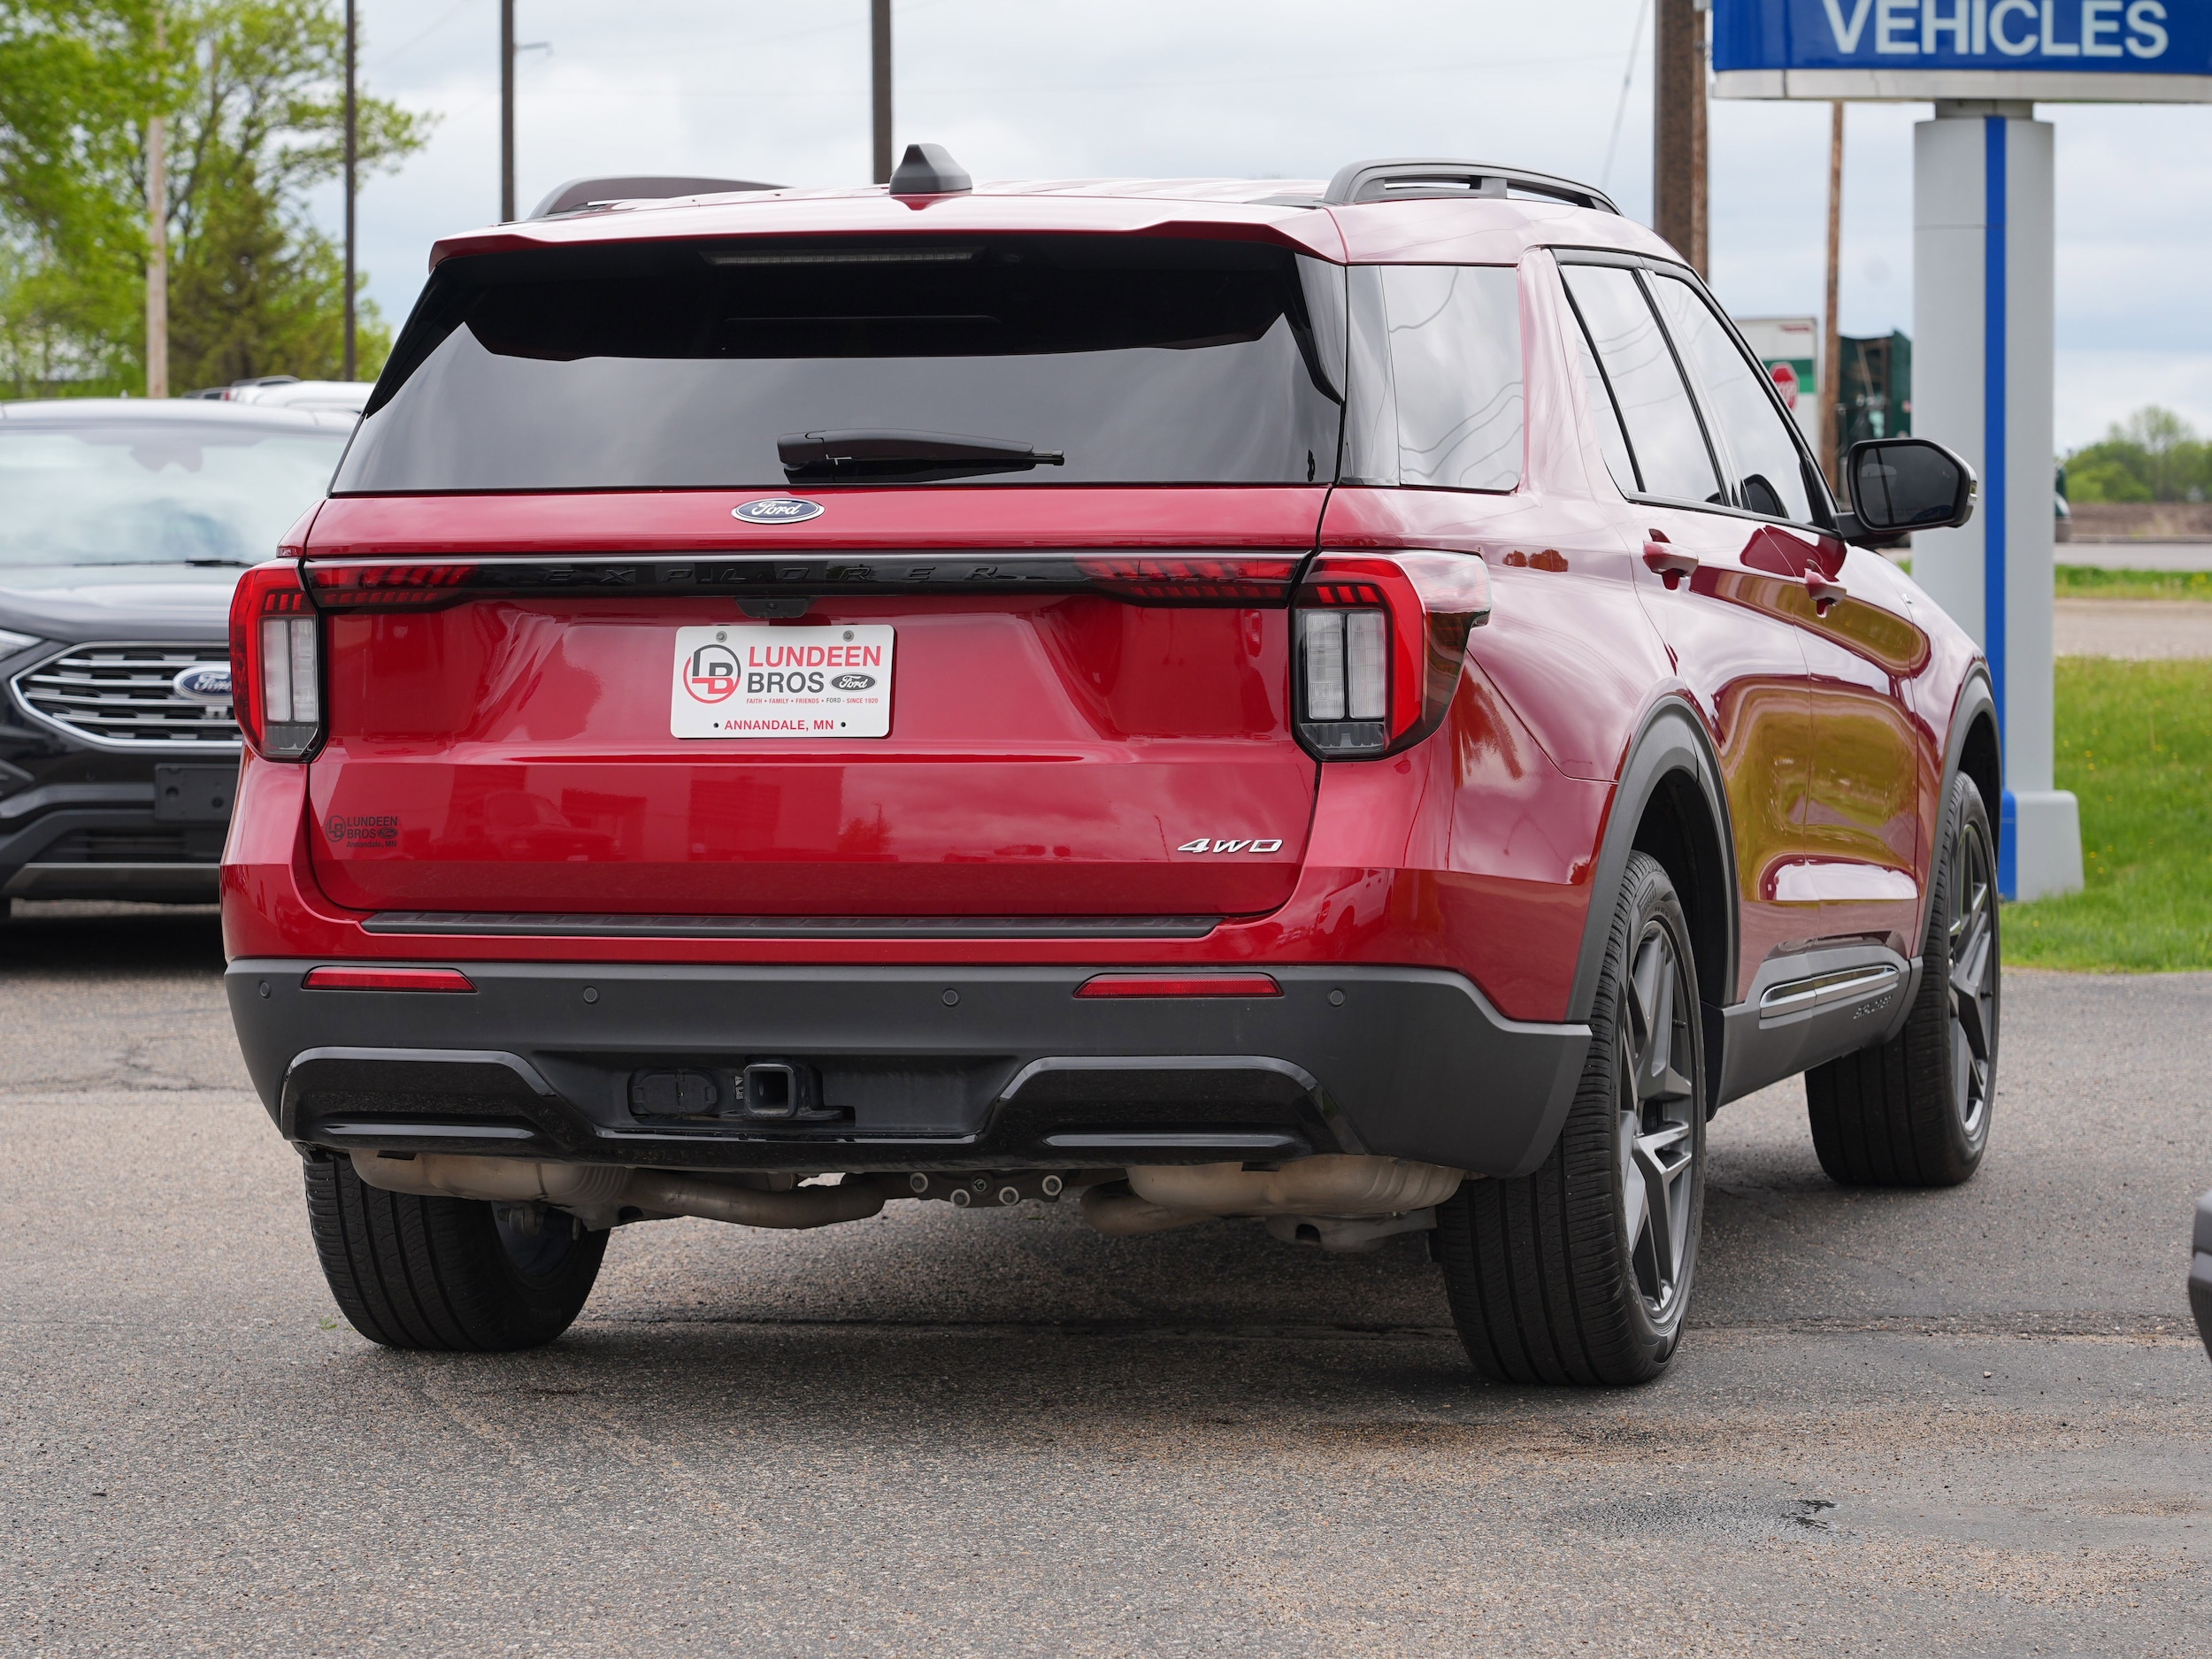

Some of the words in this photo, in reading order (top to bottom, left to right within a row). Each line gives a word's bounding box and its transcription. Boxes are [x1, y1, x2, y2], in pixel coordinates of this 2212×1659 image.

[1821, 0, 2170, 58] VEHICLES
[751, 501, 803, 515] Ford
[544, 565, 999, 582] EXPLORER
[748, 646, 881, 667] LUNDEEN
[747, 672, 825, 694] BROS
[838, 675, 868, 689] Ford
[724, 719, 809, 732] ANNANDALE,
[813, 719, 834, 730] MN
[347, 816, 398, 826] LUNDEEN
[347, 828, 376, 839] BROS
[1177, 838, 1283, 853] 4WD
